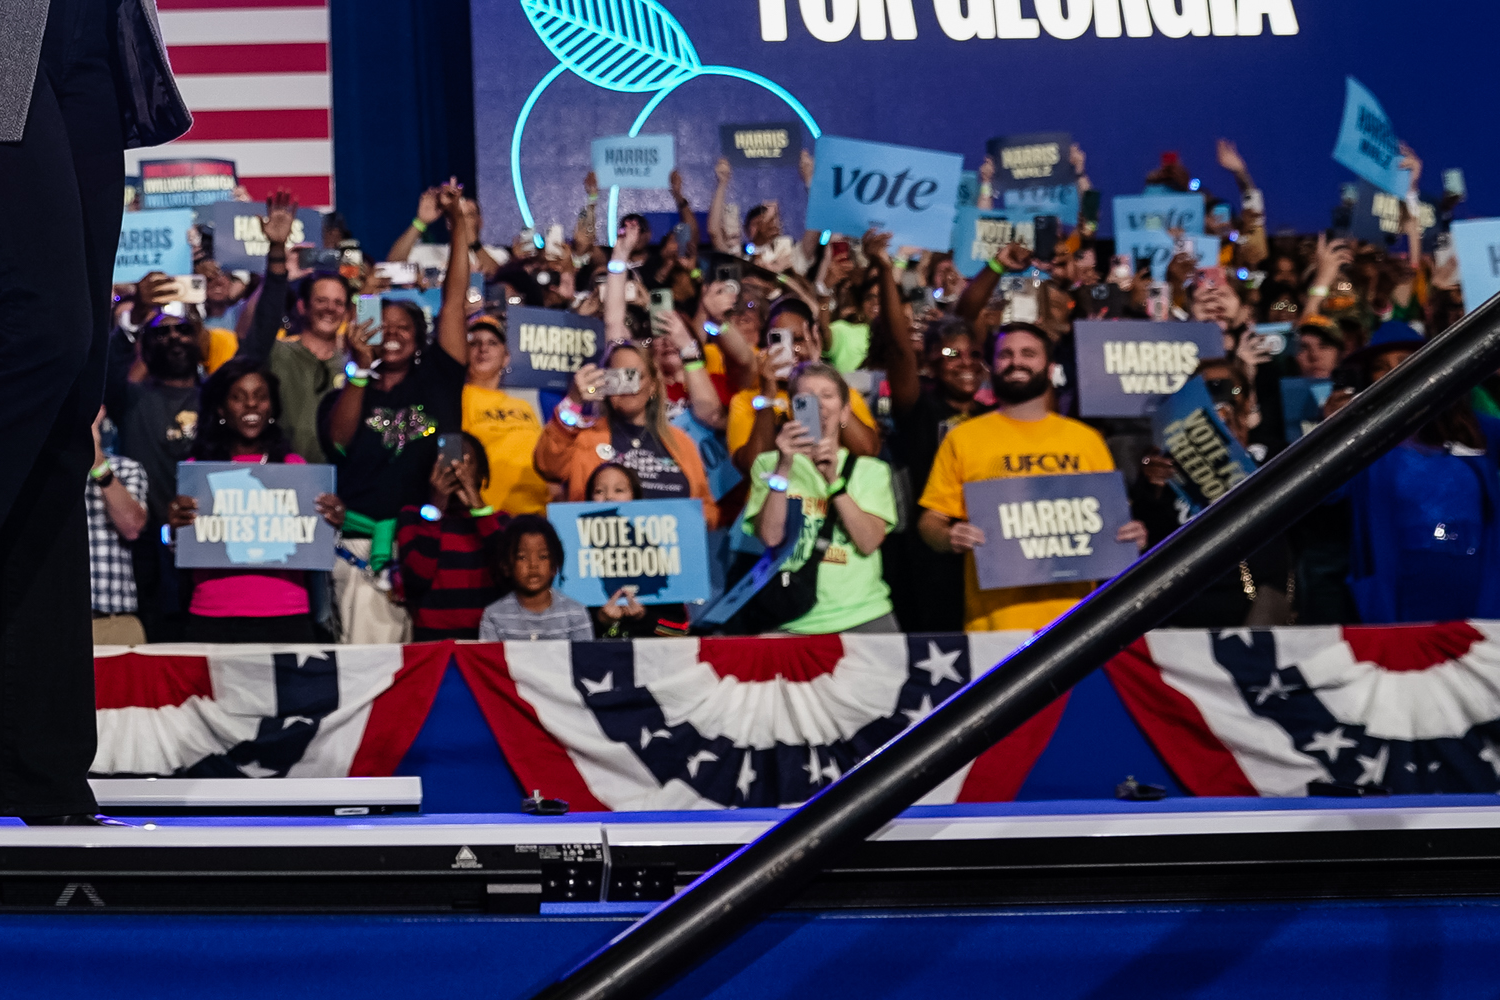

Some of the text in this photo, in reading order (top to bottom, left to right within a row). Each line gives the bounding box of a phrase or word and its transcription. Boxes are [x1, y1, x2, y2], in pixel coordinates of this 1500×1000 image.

[734, 128, 789, 149] HARRIS
[604, 146, 658, 166] HARRIS
[743, 148, 783, 158] WALZ
[613, 166, 651, 177] WALZ
[832, 165, 938, 212] vote
[119, 228, 173, 251] ARRIS
[519, 323, 597, 357] HARRIS
[530, 353, 582, 373] WALZ
[1104, 340, 1199, 376] HARRIS
[1118, 373, 1187, 394] WALZ
[1002, 455, 1079, 472] UFCW
[1163, 421, 1224, 504] FREEDO
[212, 488, 299, 516] ATLANTA
[194, 516, 317, 543] VOTES EARLY
[999, 496, 1103, 539] HARRIS
[576, 515, 678, 548] VOTE FOR
[1019, 534, 1093, 560] WALZ
[577, 547, 681, 579] FREEDOM
